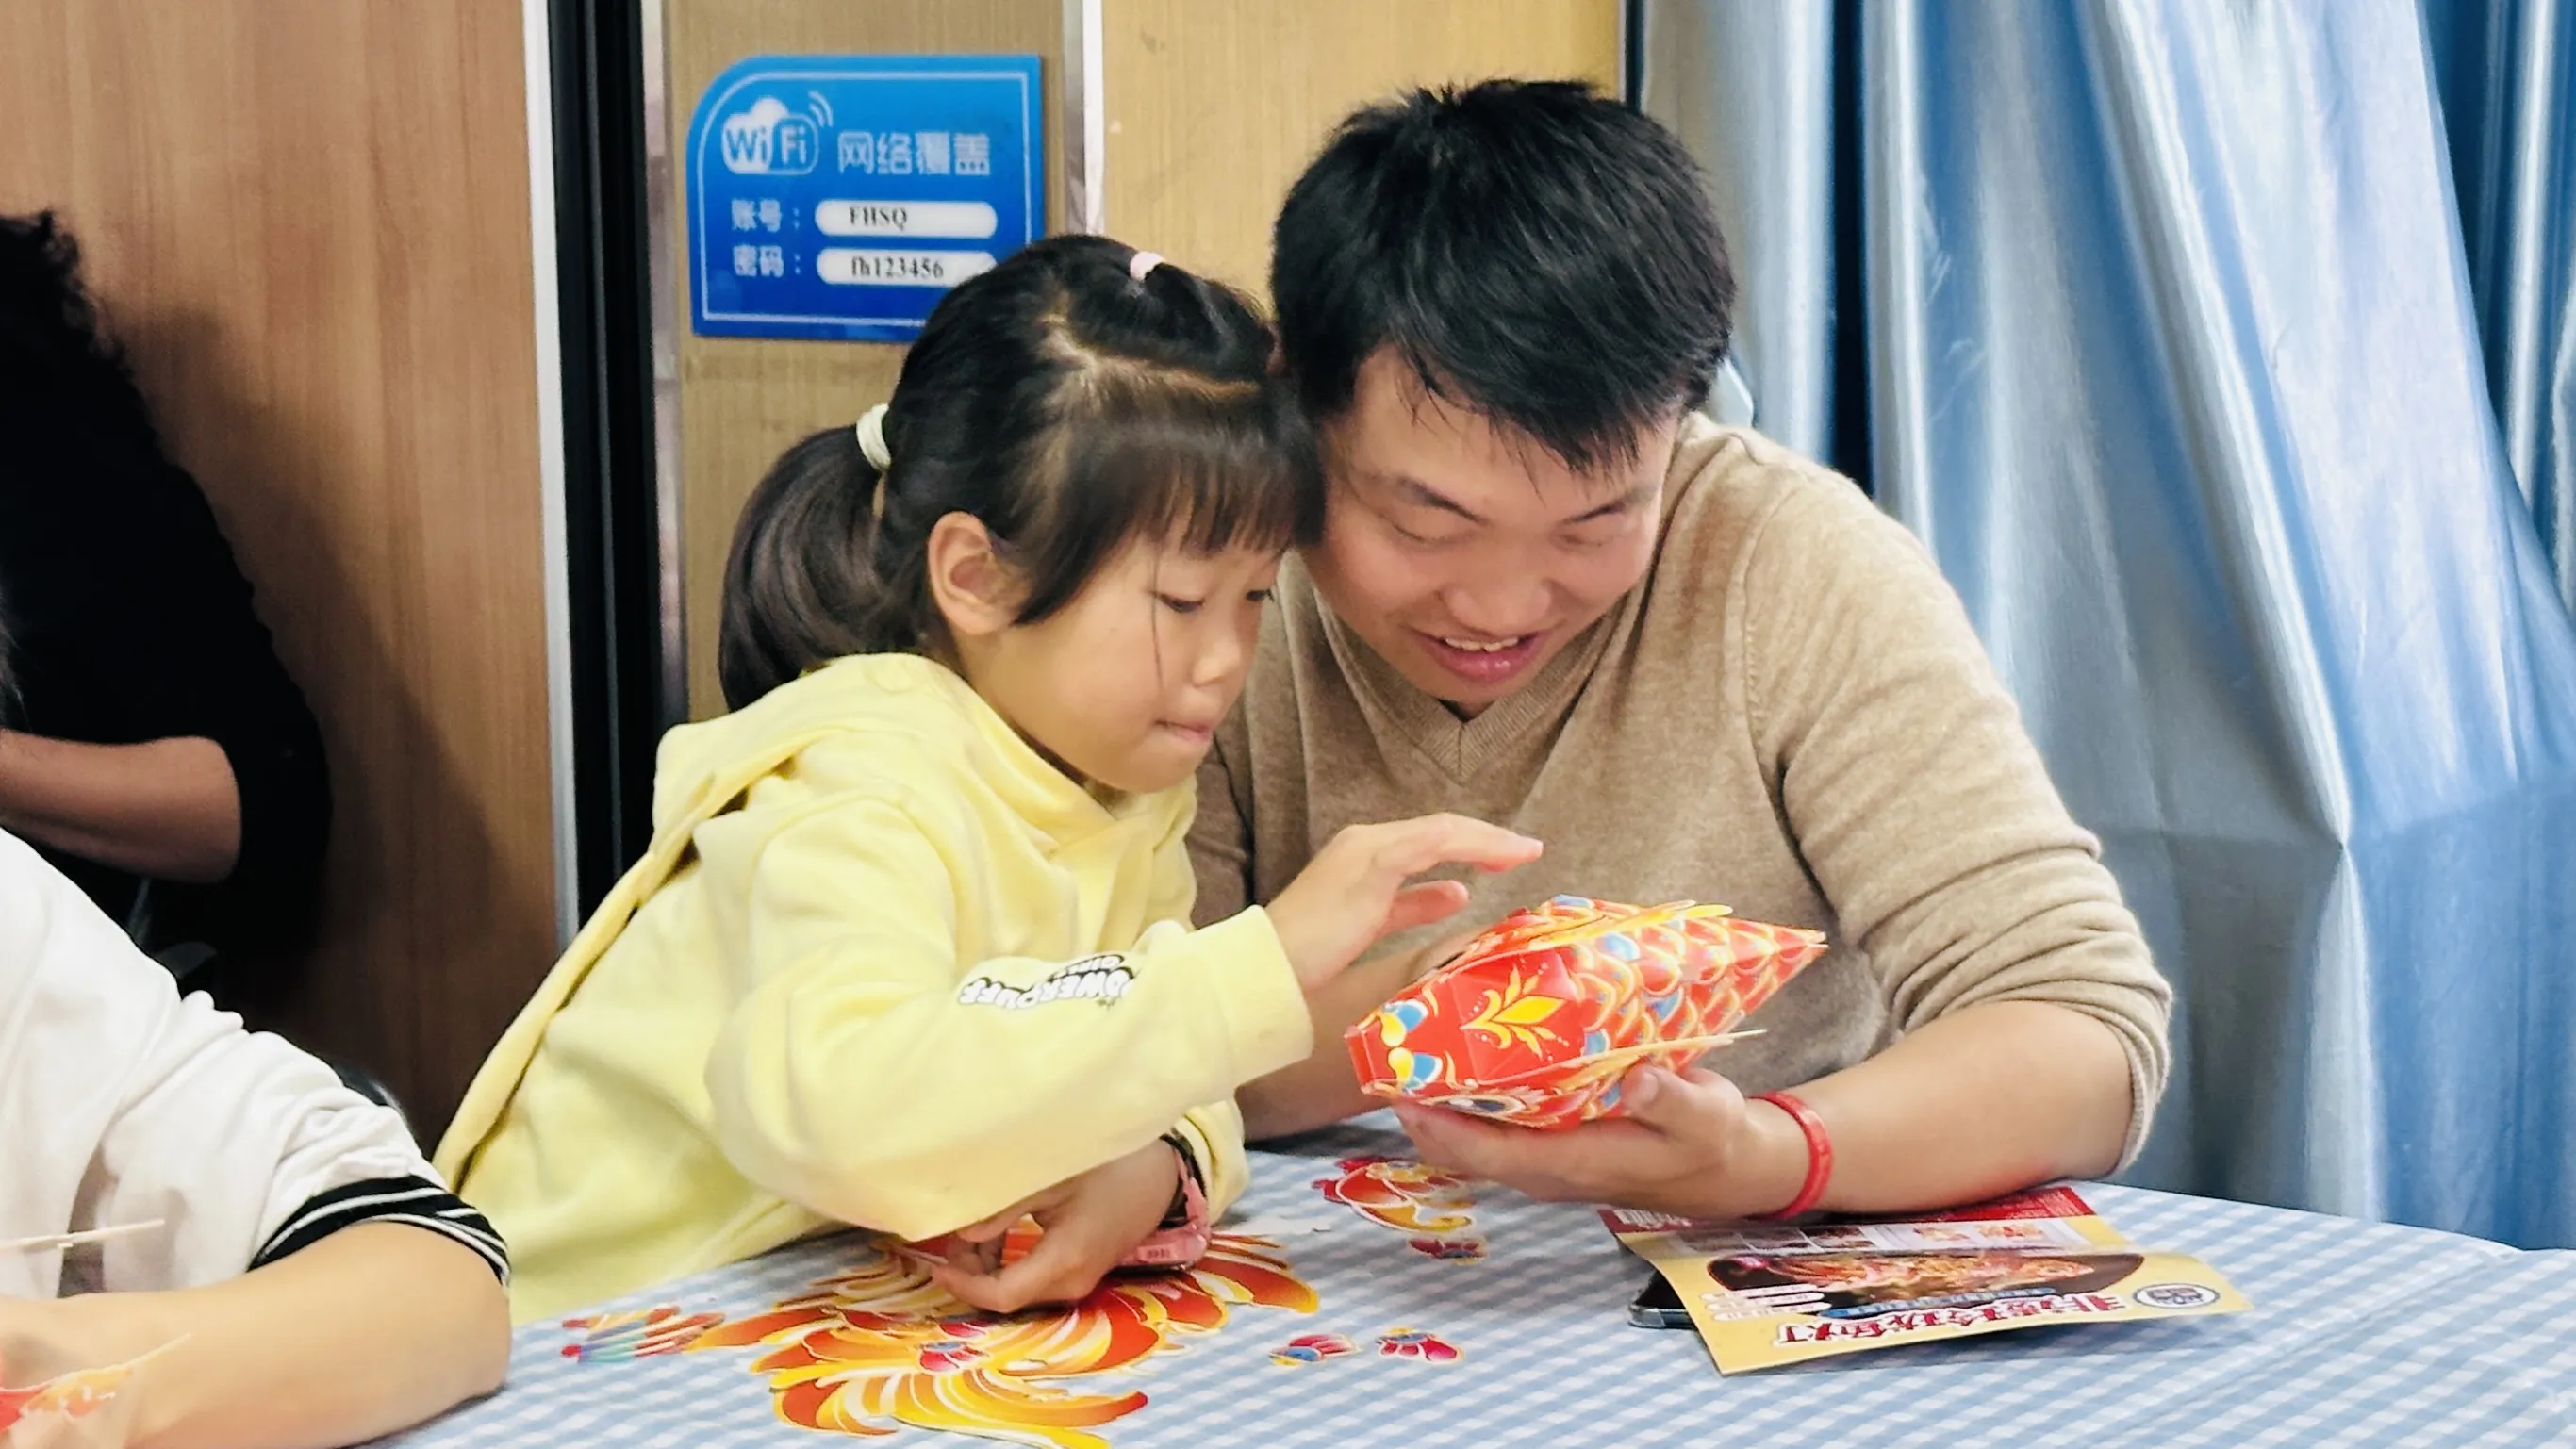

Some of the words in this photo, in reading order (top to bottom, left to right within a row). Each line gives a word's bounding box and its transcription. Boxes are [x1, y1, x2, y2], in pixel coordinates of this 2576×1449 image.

[837, 130, 991, 175] 网络覆盖
[849, 206, 908, 230] FHSQ
[850, 255, 945, 279] fh123456
